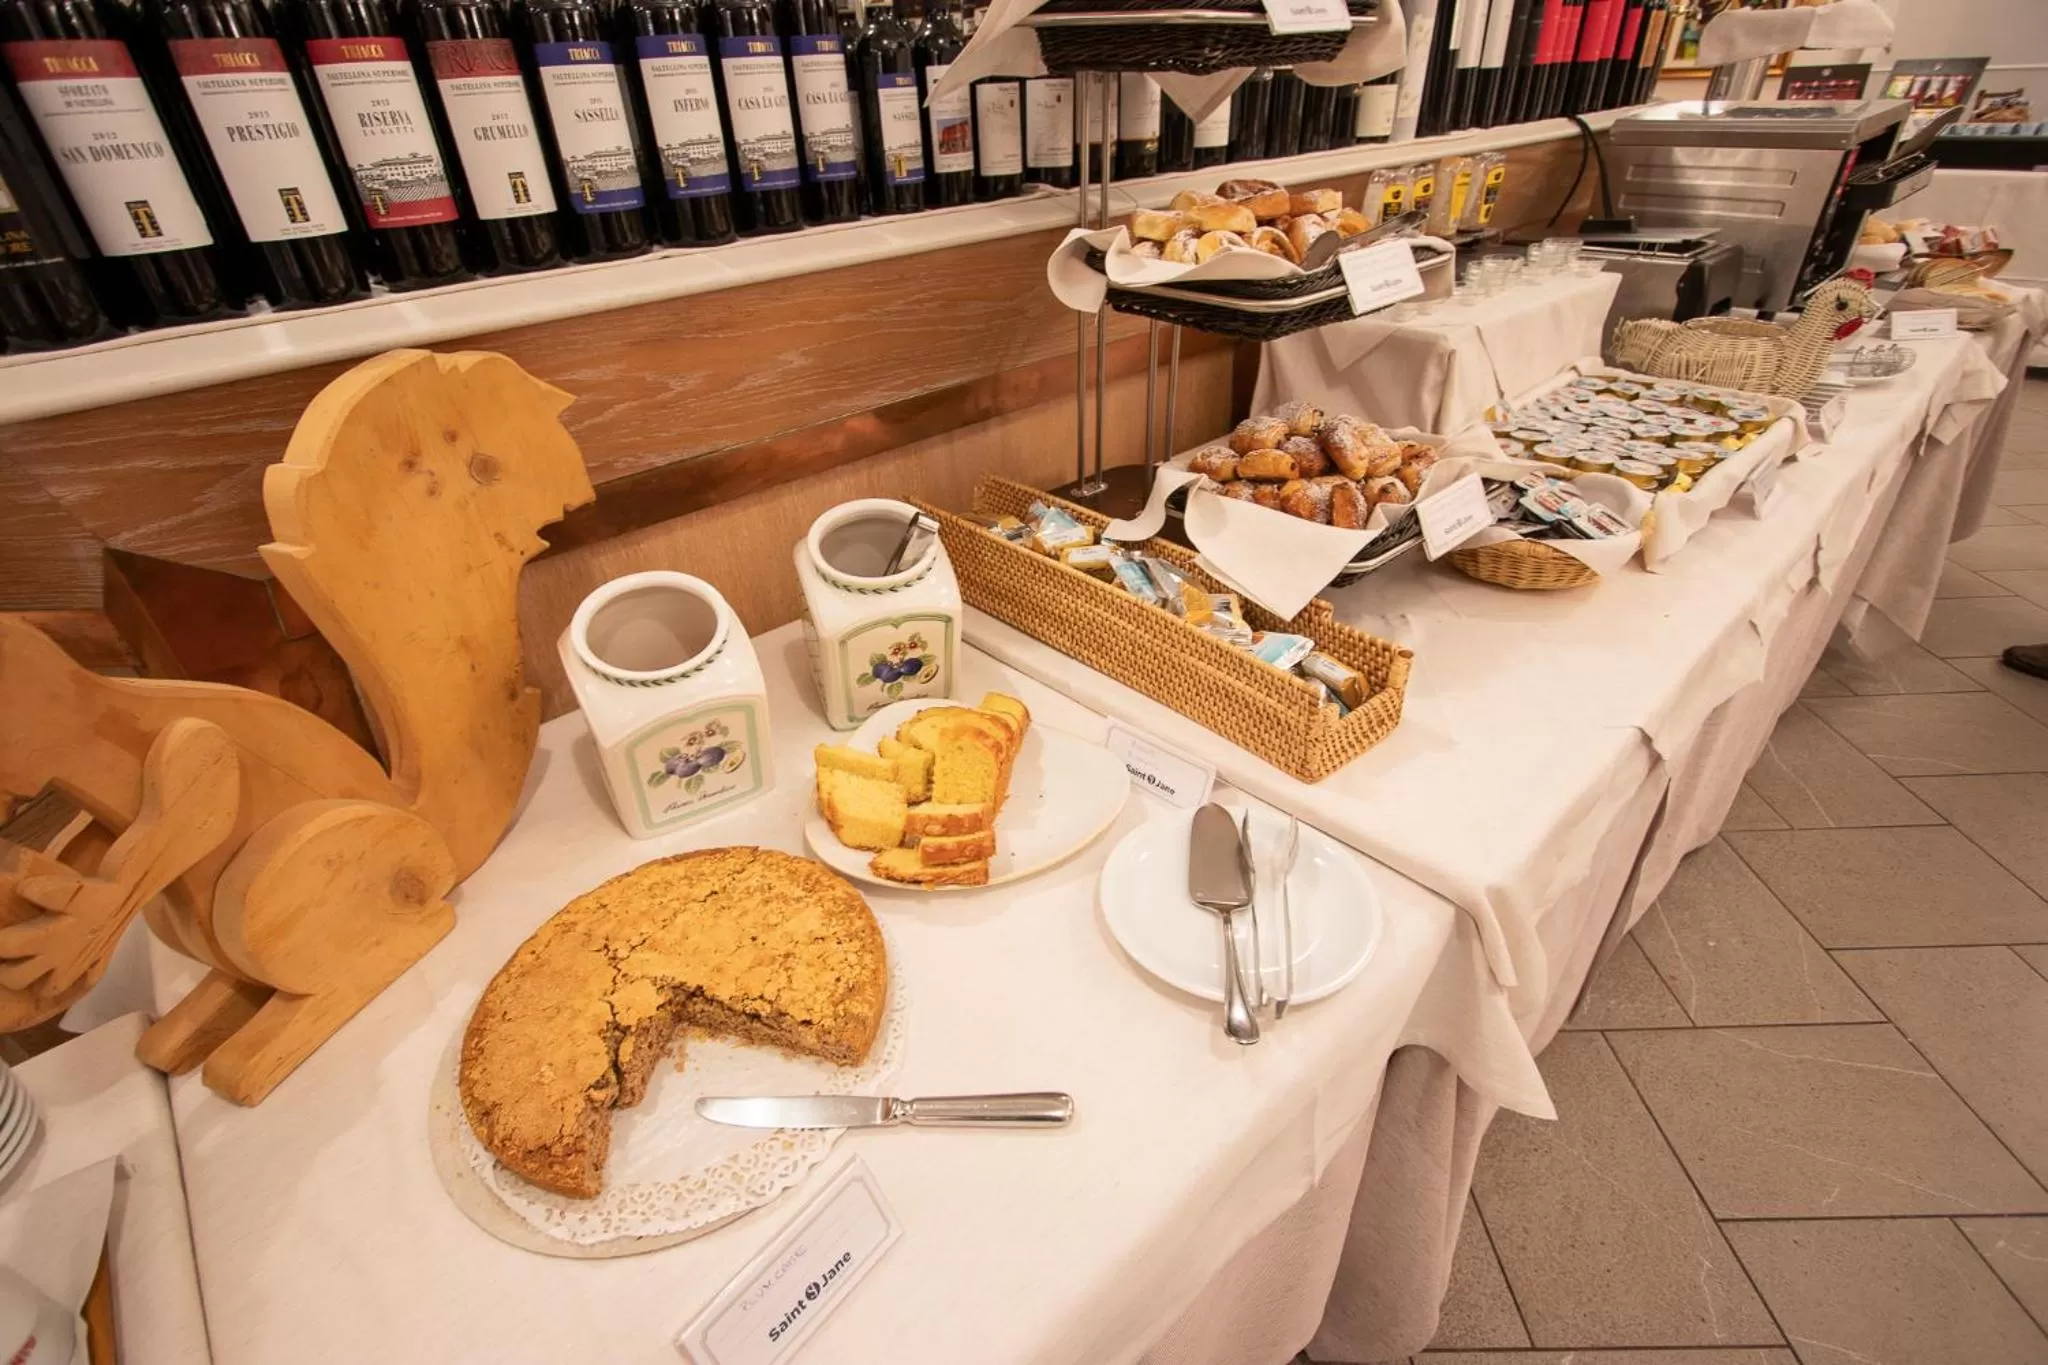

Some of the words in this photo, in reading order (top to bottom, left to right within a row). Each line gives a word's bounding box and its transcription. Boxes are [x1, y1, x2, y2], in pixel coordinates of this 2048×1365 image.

[357, 111, 413, 129] RISERVA
[225, 122, 302, 143] PRESTIGIO
[473, 124, 530, 141] GRUMELLO
[89, 141, 165, 163] DOMENICO
[768, 1299, 808, 1343] Saint
[822, 1251, 852, 1288] Jane
